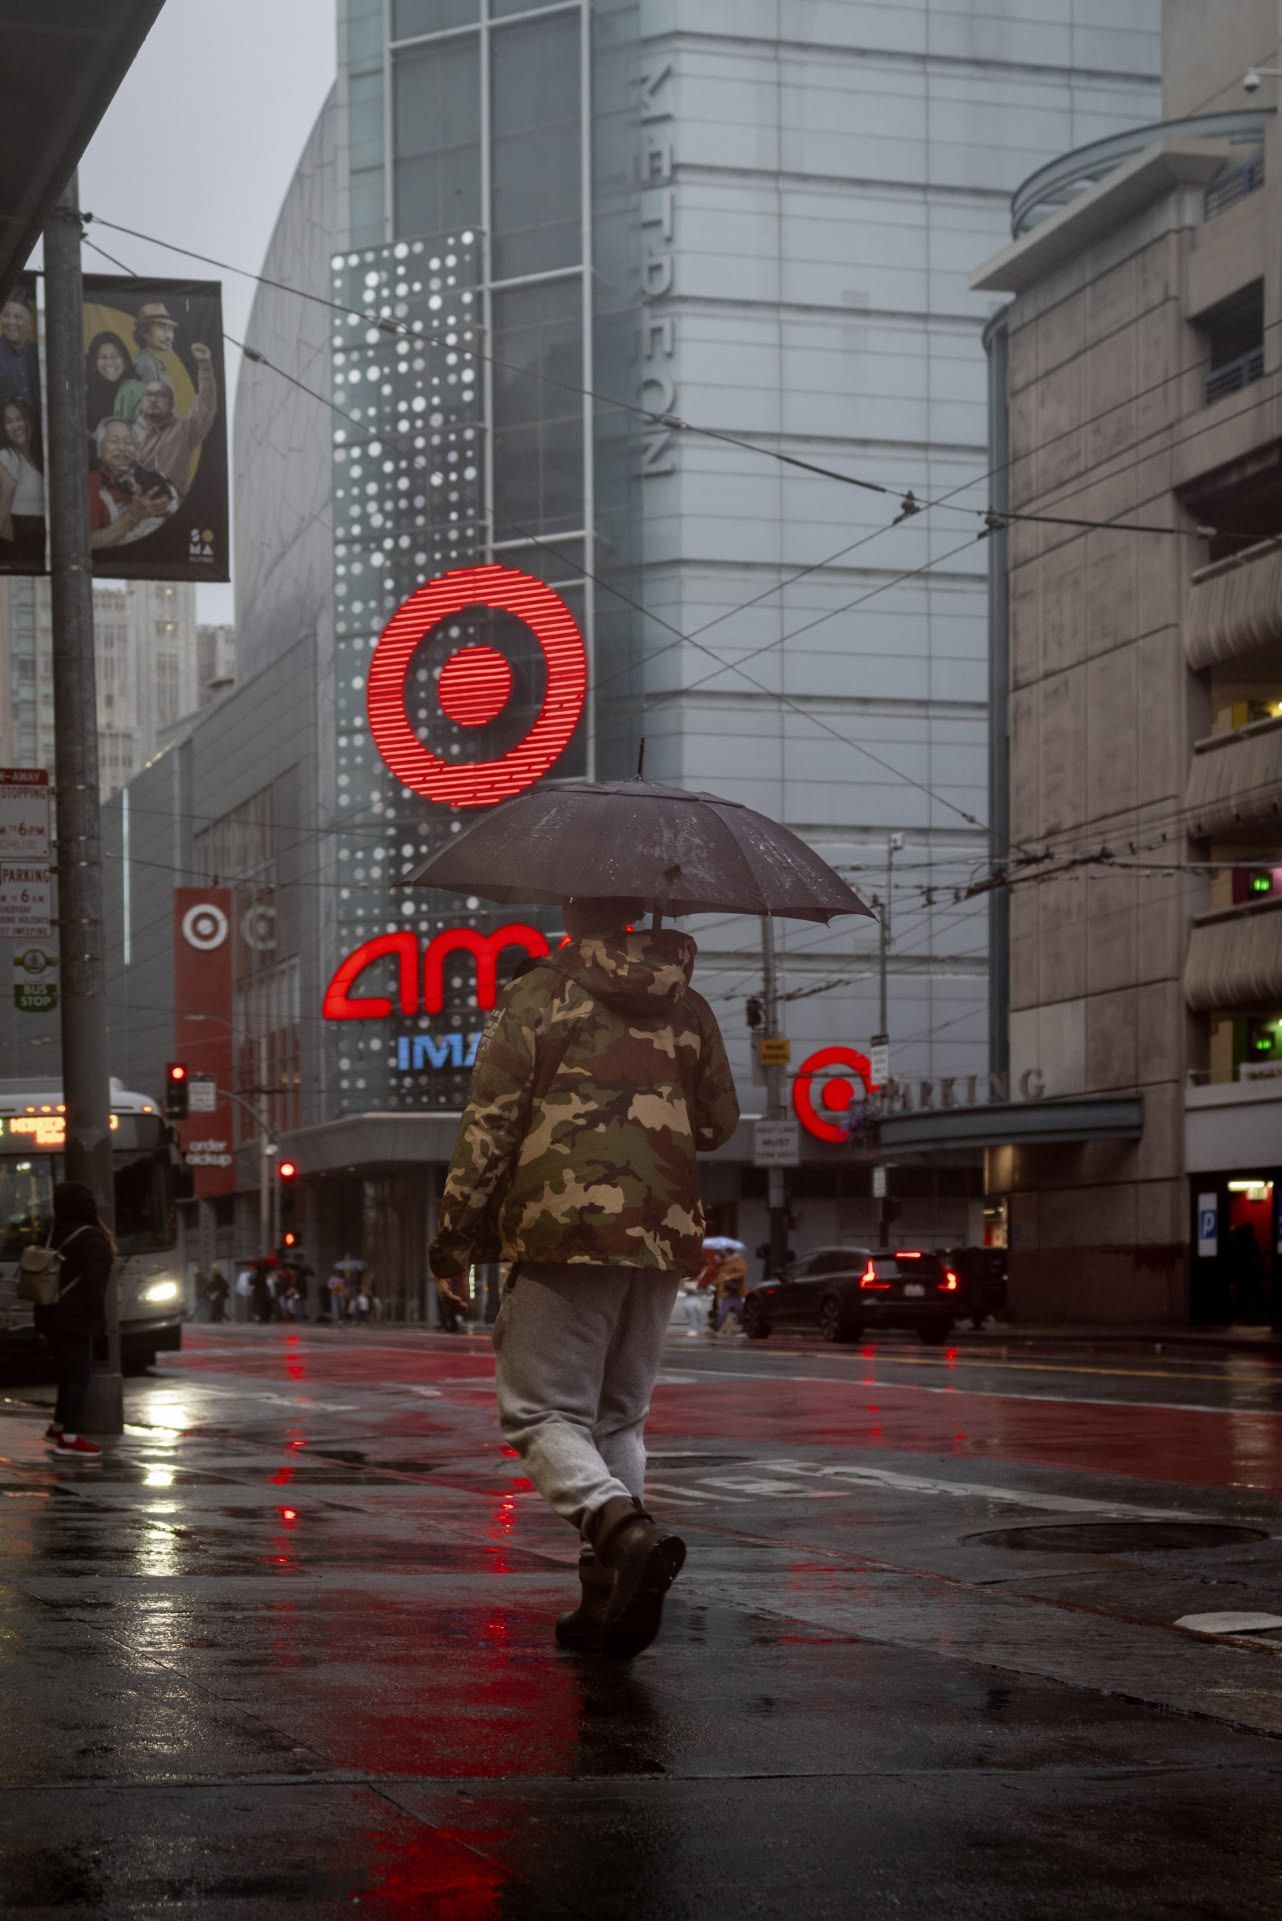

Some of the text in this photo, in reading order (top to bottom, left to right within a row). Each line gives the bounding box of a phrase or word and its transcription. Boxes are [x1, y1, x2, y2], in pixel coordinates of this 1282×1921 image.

[18, 822, 28, 836] 6
[2, 868, 49, 883] PARKING
[20, 888, 30, 903] 6
[23, 984, 48, 995] BUS
[20, 995, 52, 1007] STOP
